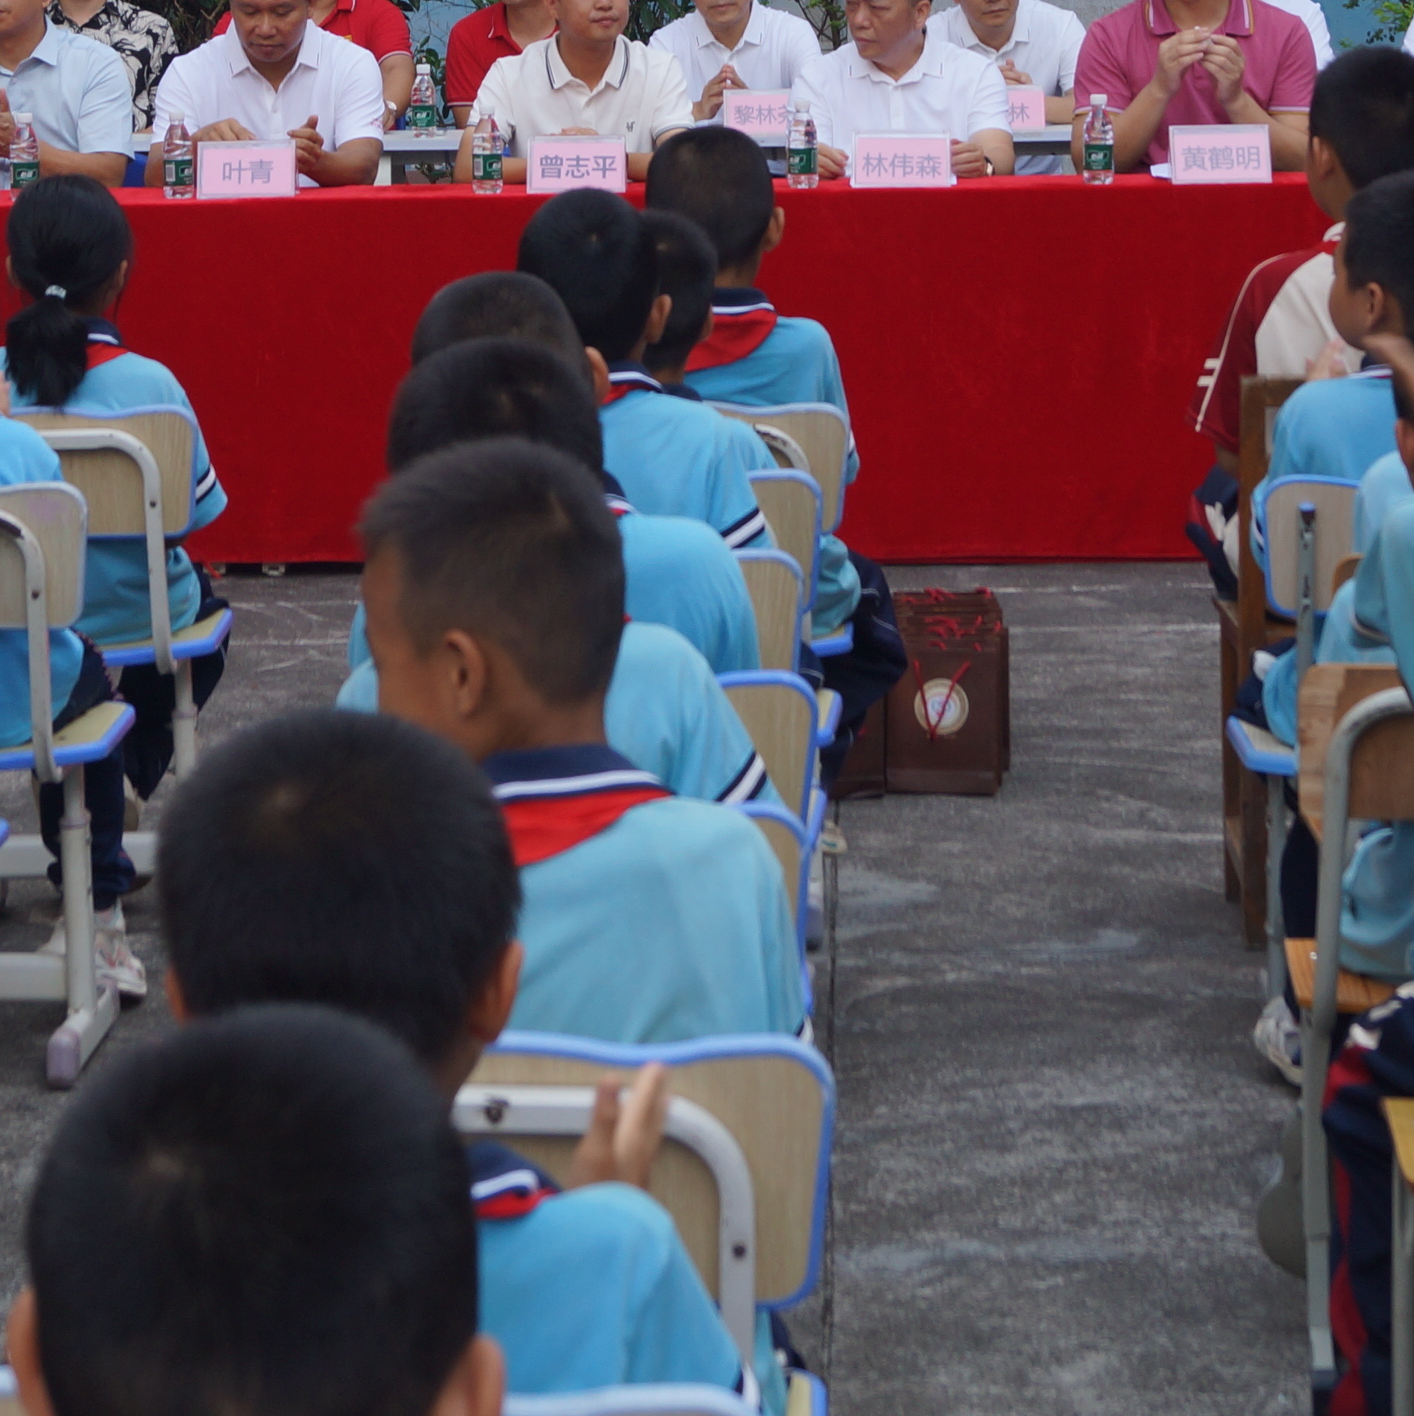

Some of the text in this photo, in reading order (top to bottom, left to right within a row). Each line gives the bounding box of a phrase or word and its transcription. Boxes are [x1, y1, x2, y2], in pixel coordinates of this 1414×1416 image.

[539, 154, 618, 180] 曾志平
[862, 152, 943, 178] 林伟森
[1182, 145, 1262, 172] 黄鹤明
[222, 159, 274, 185] 叶青
